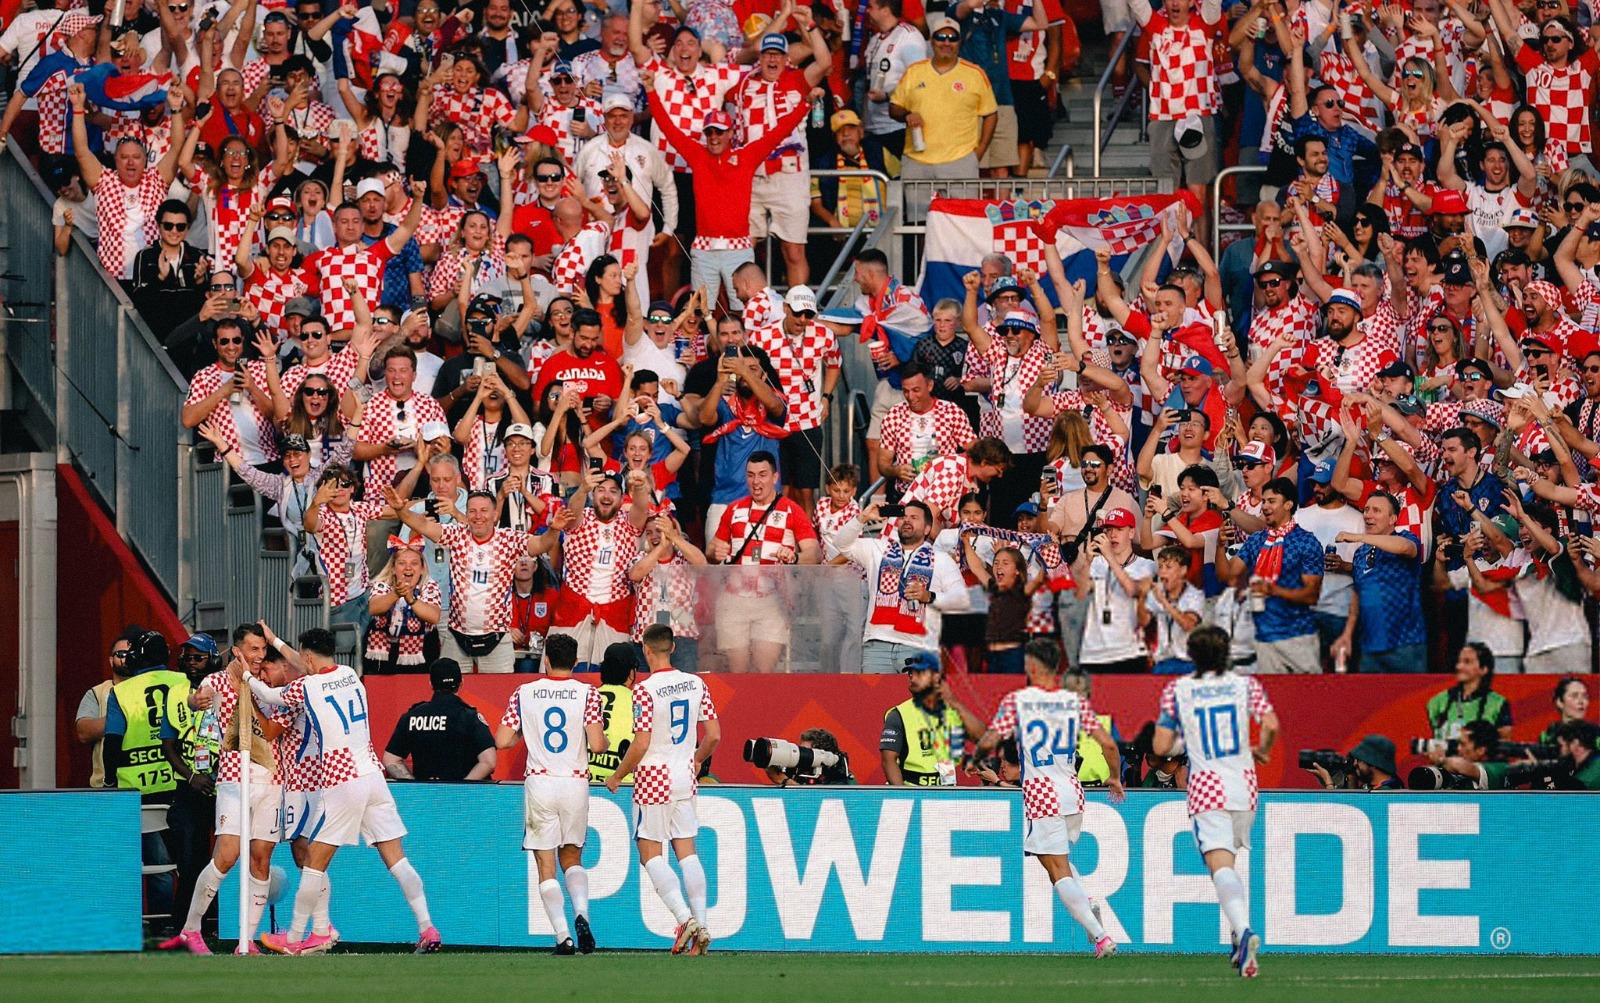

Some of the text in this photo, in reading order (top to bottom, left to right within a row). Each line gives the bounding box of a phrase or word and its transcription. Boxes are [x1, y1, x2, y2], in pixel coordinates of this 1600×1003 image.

[1537, 71, 1552, 89] 10
[555, 368, 606, 381] CANADA
[599, 550, 612, 565] 10
[472, 569, 488, 585] 10
[324, 688, 368, 735] 14
[409, 715, 448, 731] POLICE
[543, 706, 569, 754] 8
[670, 698, 690, 745] 9
[1194, 704, 1240, 761] 10
[1027, 717, 1076, 768] 24
[129, 748, 166, 764] SECU
[138, 768, 172, 787] 175
[527, 796, 1480, 947] POWERADE
